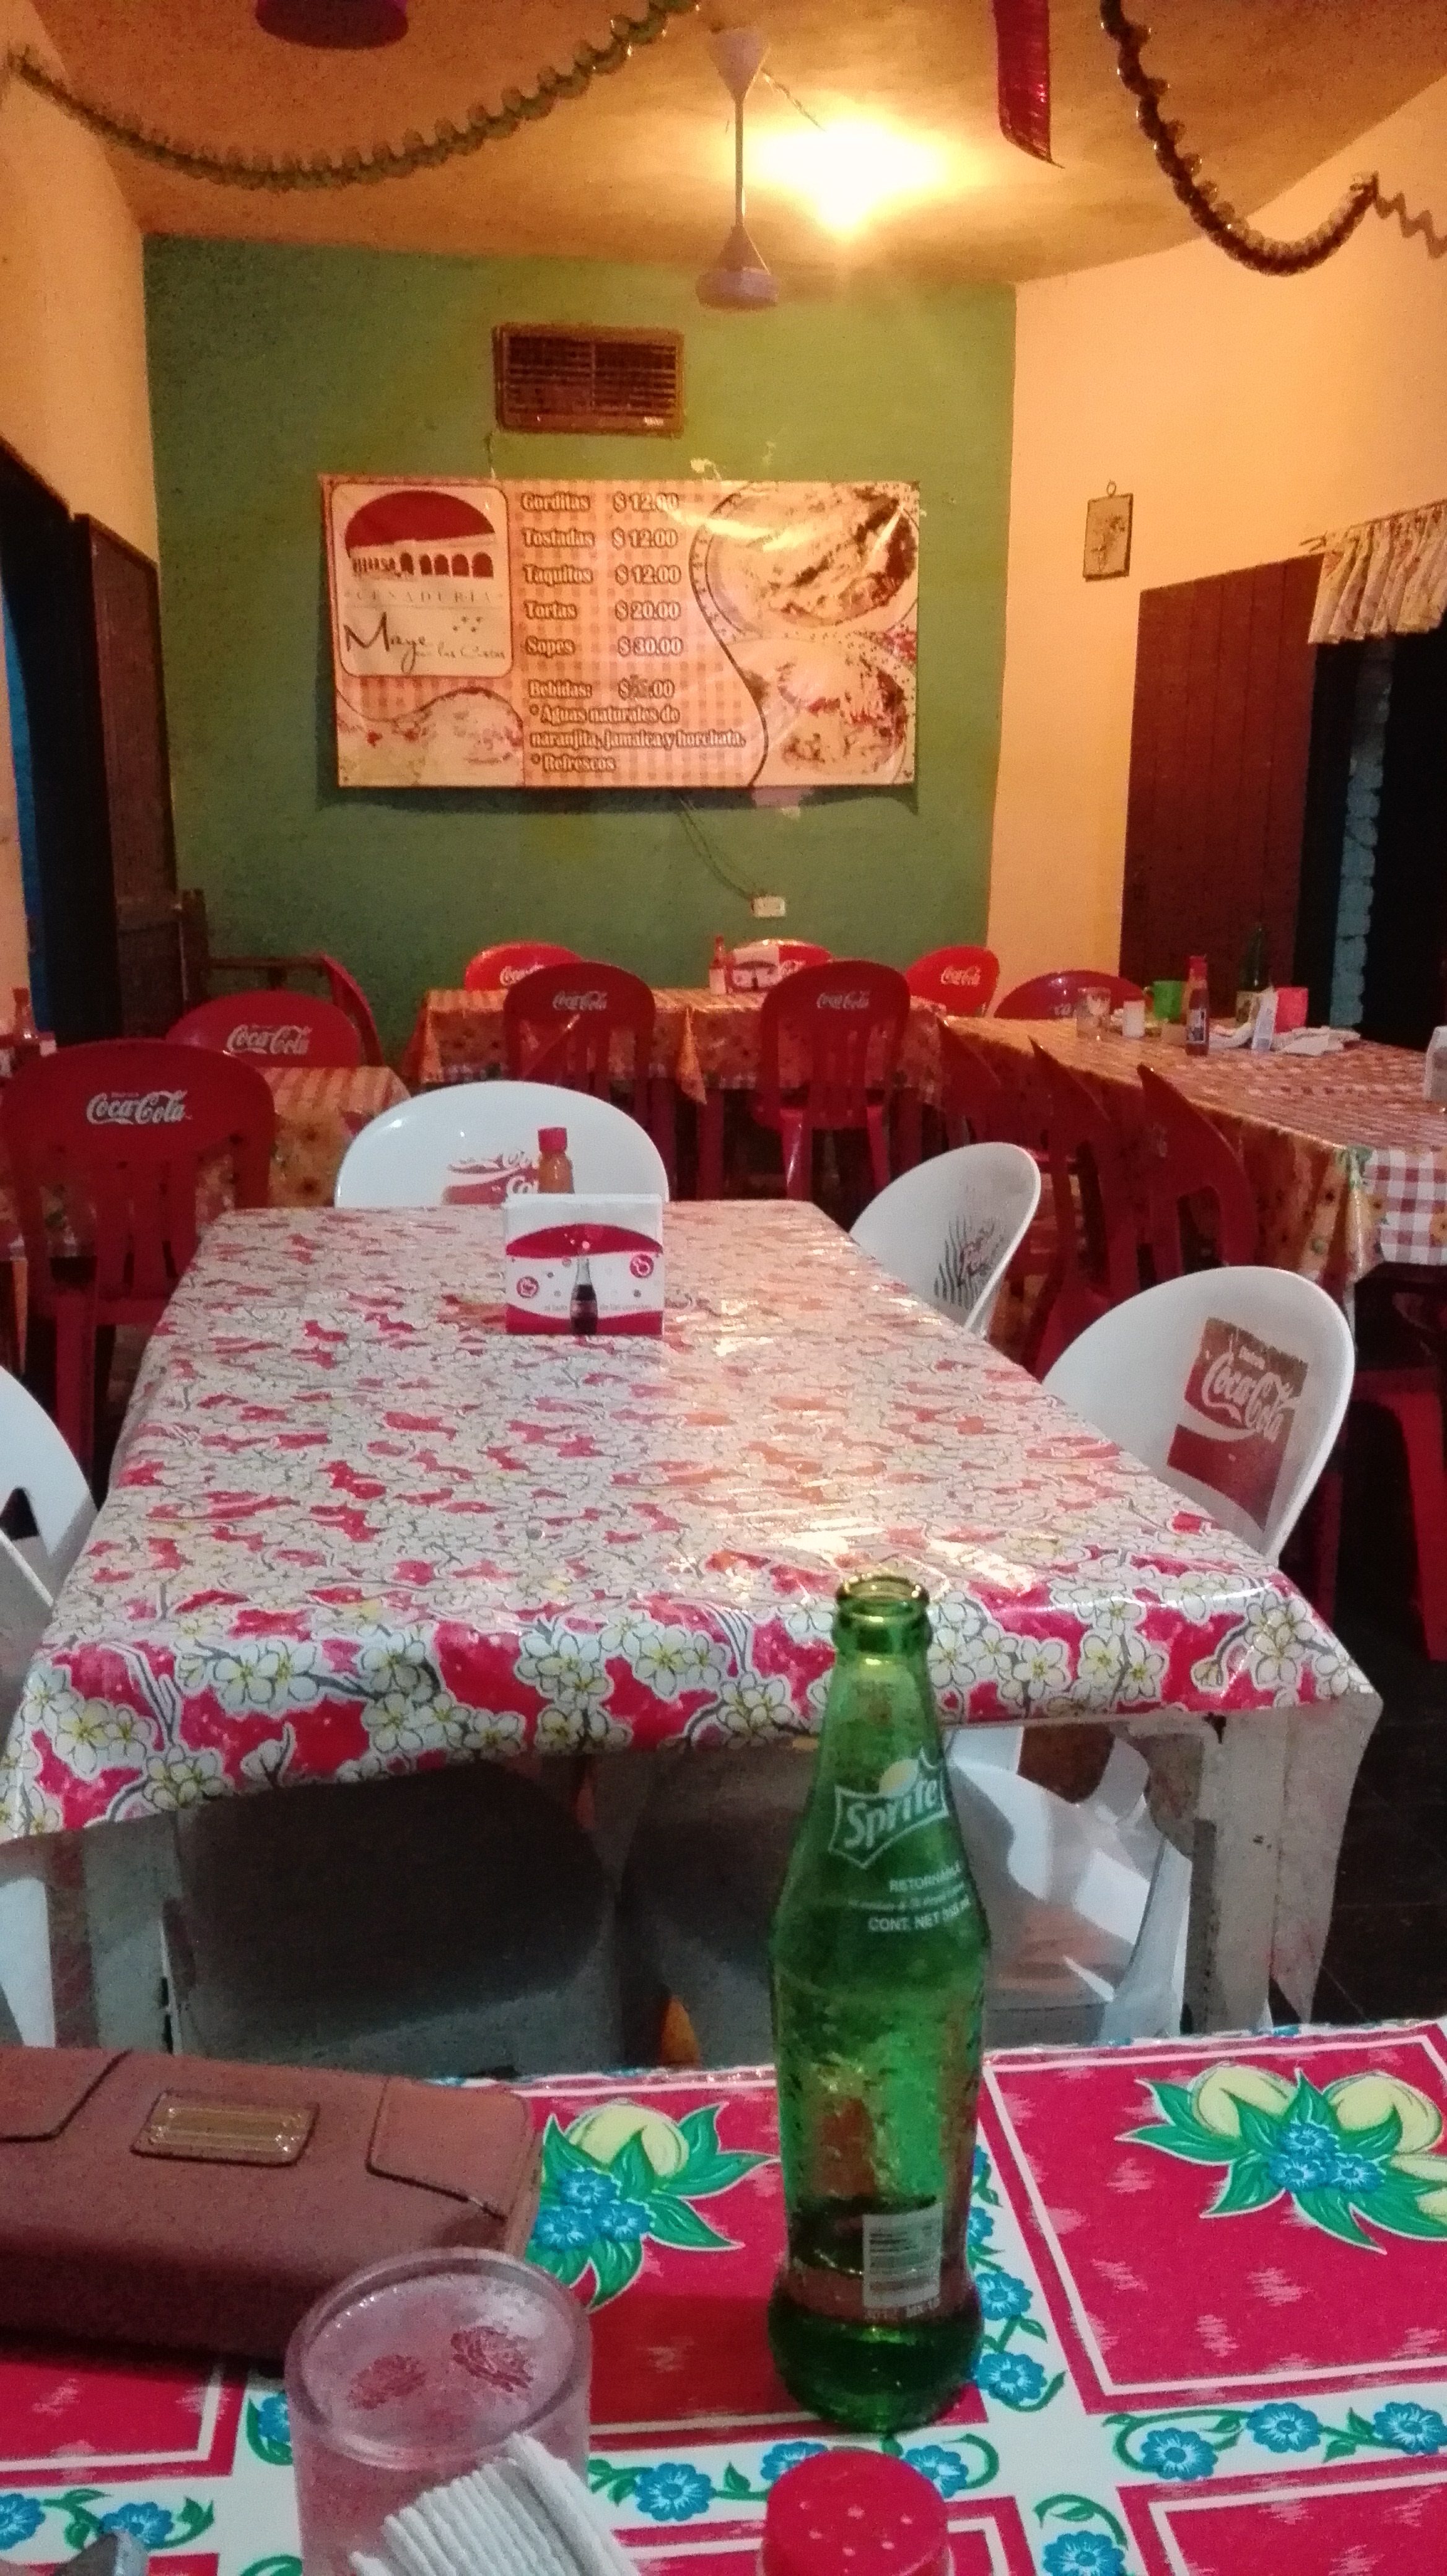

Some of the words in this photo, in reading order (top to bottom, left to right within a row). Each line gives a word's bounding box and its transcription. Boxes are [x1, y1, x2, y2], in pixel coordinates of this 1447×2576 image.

[520, 491, 590, 513] Gorditas
[524, 528, 595, 548] Tostadas
[523, 564, 593, 587] Taquitos
[524, 599, 577, 620] Tortas
[525, 635, 576, 658] Sopes
[528, 679, 592, 698] Bebidas:
[588, 705, 659, 723] naturales
[660, 704, 680, 723] de
[530, 729, 603, 750] naranjita,
[661, 733, 675, 751] y
[227, 1024, 313, 1055] Coca-Cola
[86, 1089, 188, 1125] Coca-Cola
[1201, 1349, 1300, 1443] Coca-Cola
[844, 1779, 938, 1850] Sprite
